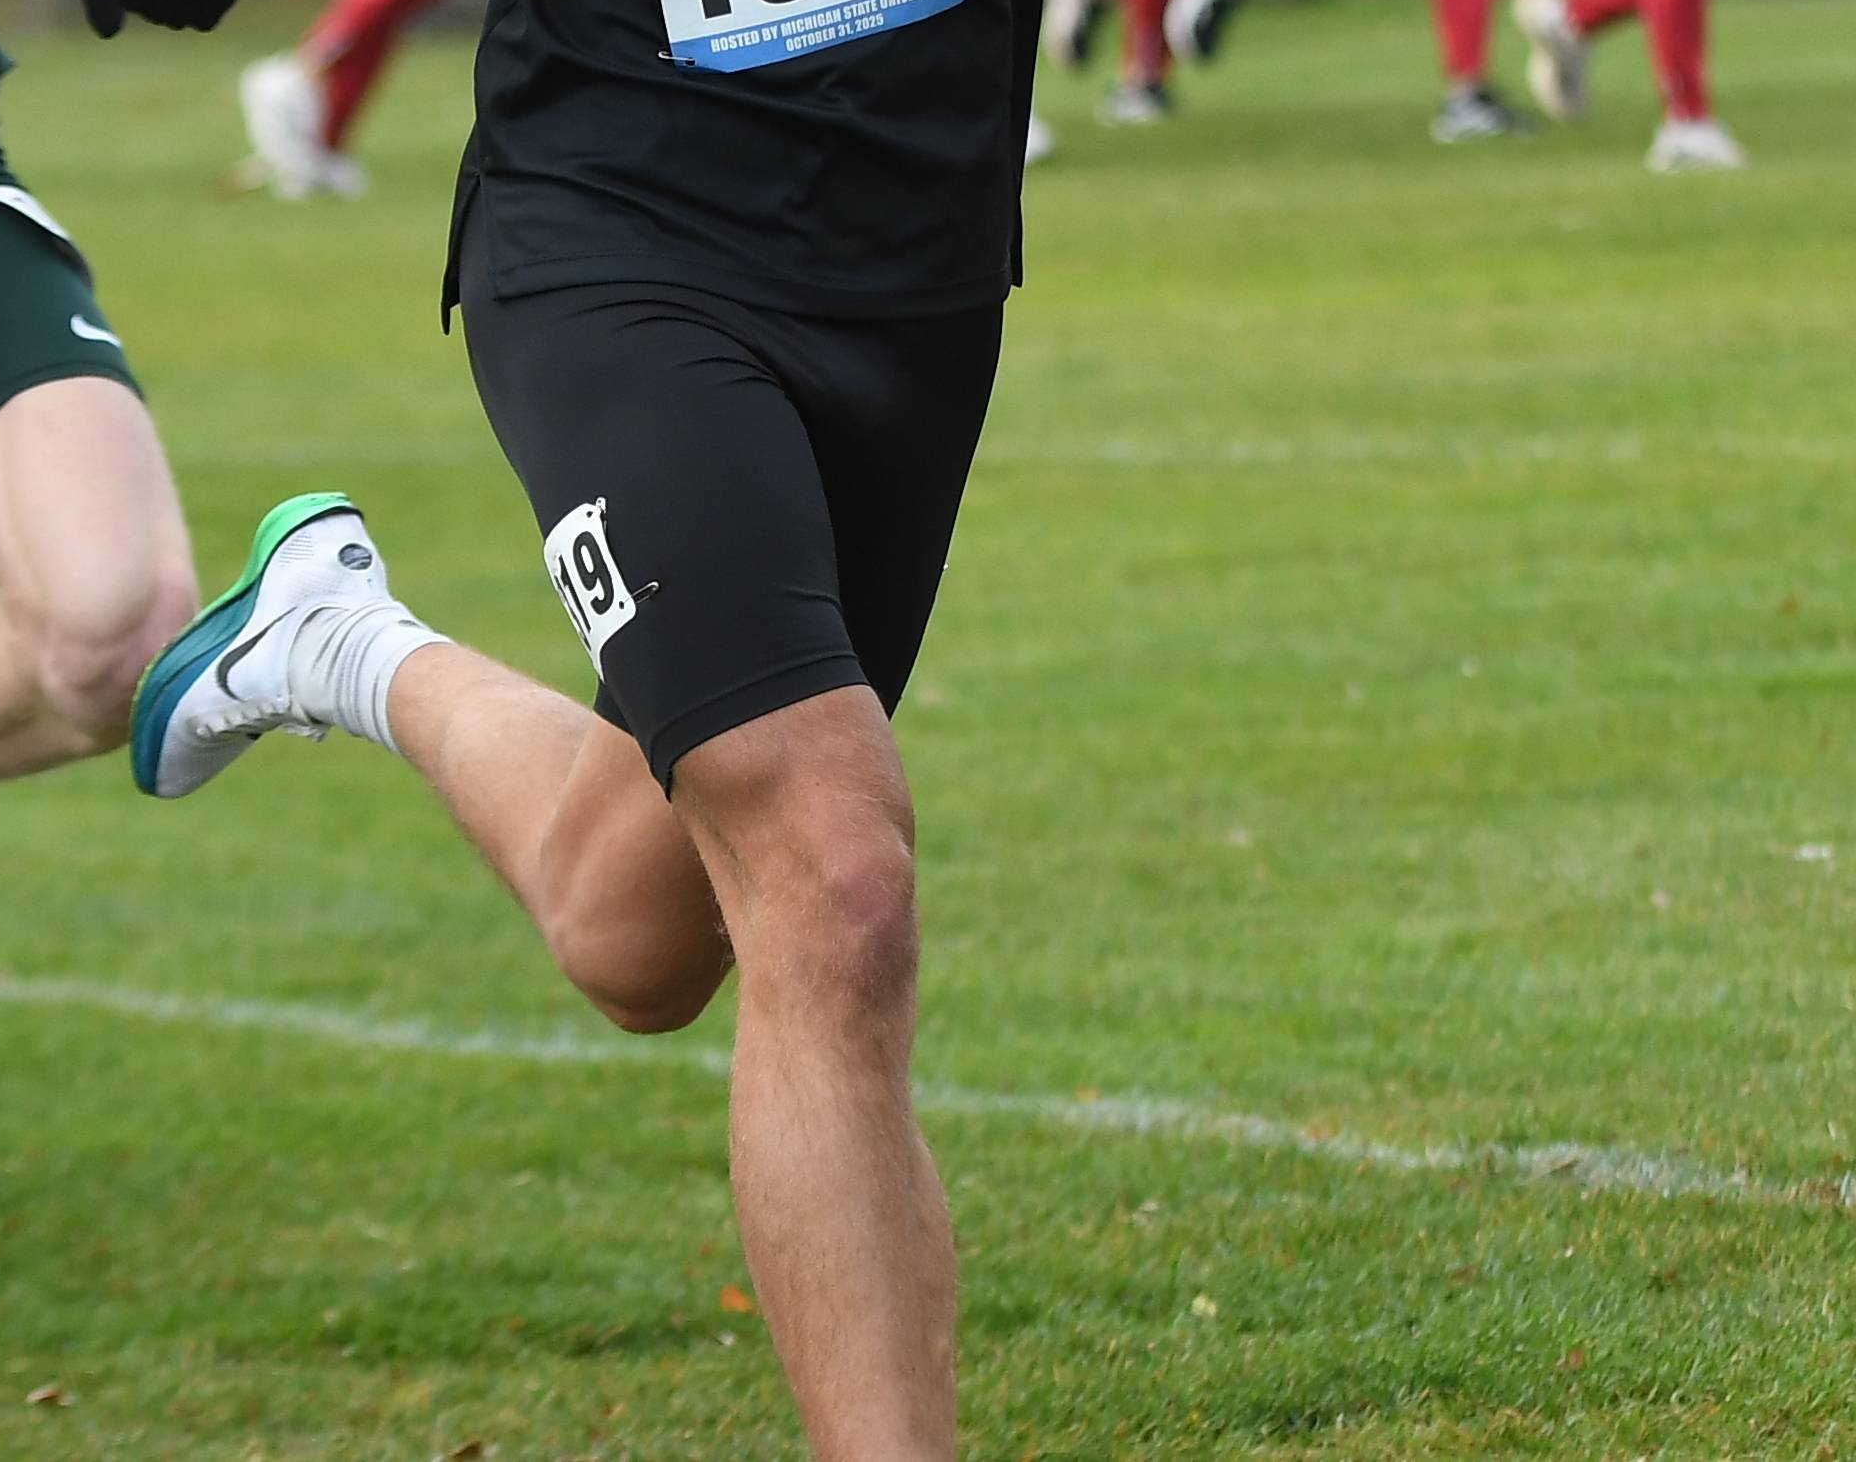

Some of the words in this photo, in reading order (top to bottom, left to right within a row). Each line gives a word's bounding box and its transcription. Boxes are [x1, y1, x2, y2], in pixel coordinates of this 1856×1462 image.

[710, 32, 760, 53] HOSTED
[762, 28, 779, 42] BY
[781, 12, 841, 37] MICHIGAN
[785, 26, 836, 52] OCTOBER
[838, 22, 854, 36] 31,
[855, 13, 885, 33] 2025
[554, 530, 615, 651] 19
